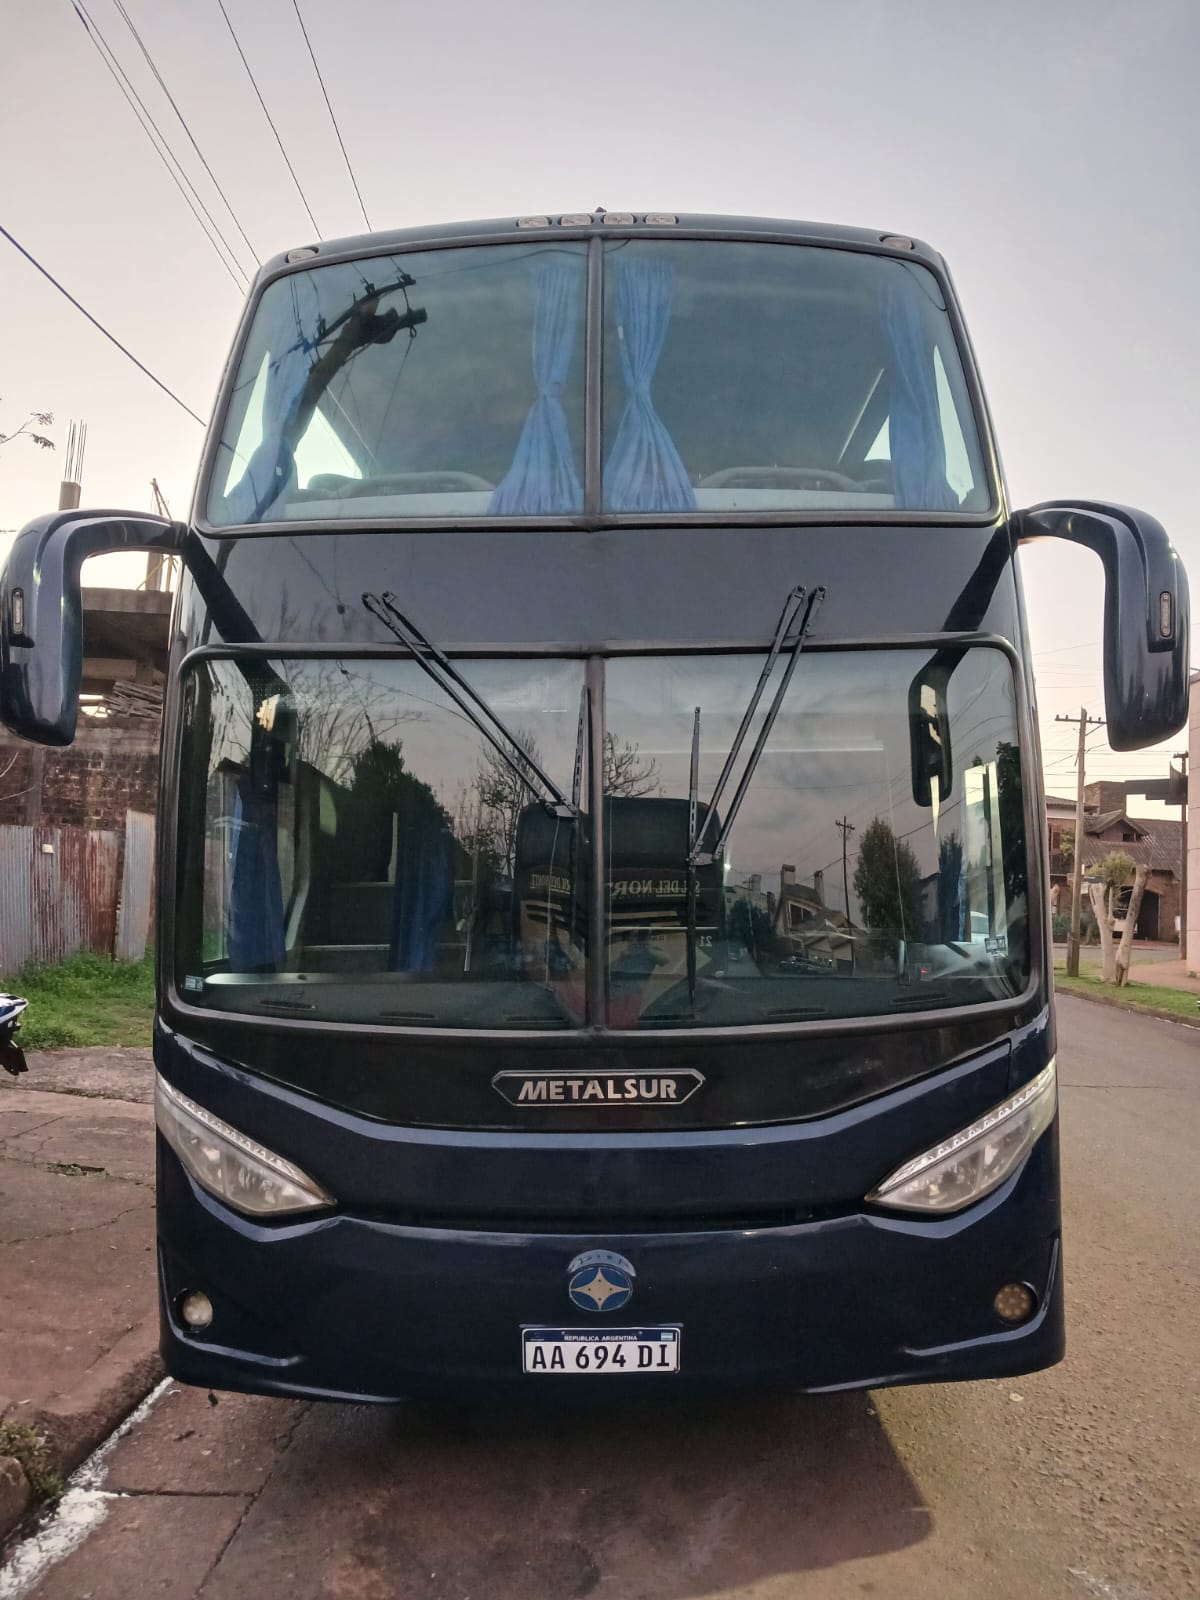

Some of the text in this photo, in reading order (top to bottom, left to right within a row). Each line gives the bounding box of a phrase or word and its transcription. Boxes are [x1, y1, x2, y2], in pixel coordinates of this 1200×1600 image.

[518, 1079, 677, 1100] METALSUR
[532, 1344, 670, 1369] AA 694 DI
